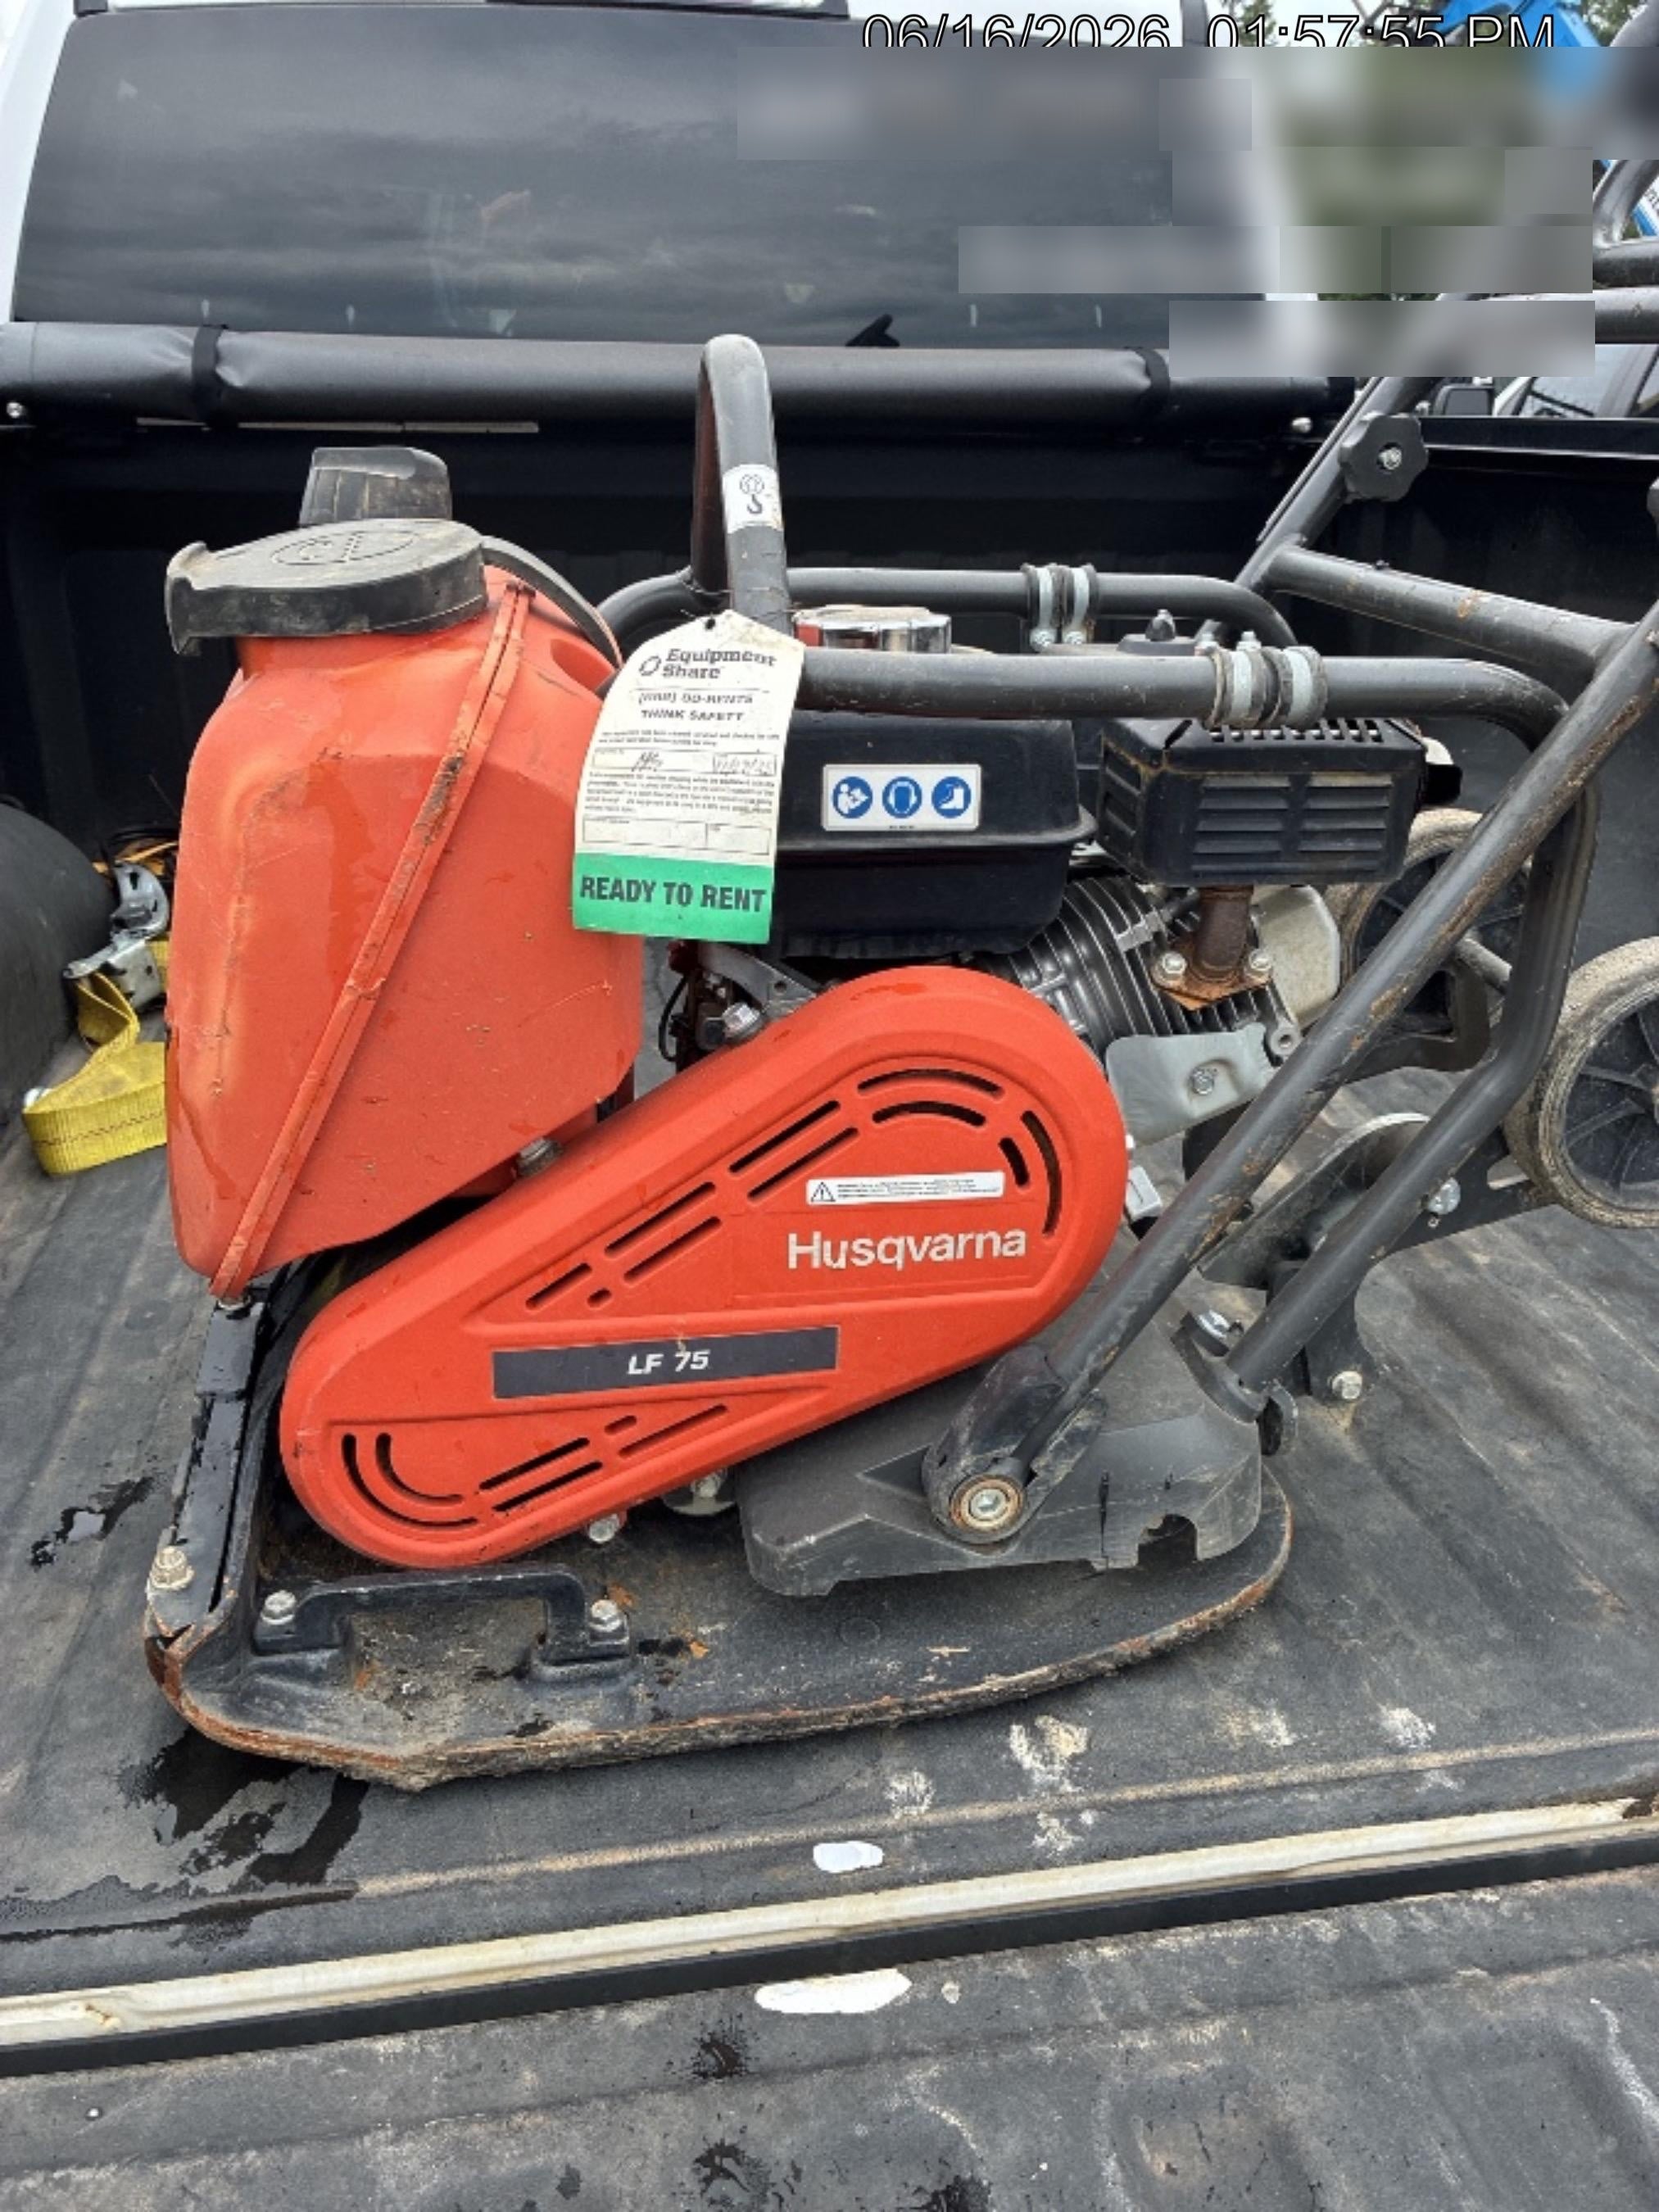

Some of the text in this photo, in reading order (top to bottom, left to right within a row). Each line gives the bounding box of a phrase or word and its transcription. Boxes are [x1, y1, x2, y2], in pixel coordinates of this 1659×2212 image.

[665, 648, 777, 667] Equipment
[662, 663, 721, 679] Share
[579, 875, 767, 913] READY TO RENT
[787, 1228, 1027, 1271] Husqvarna
[627, 1349, 711, 1375] LF 75
